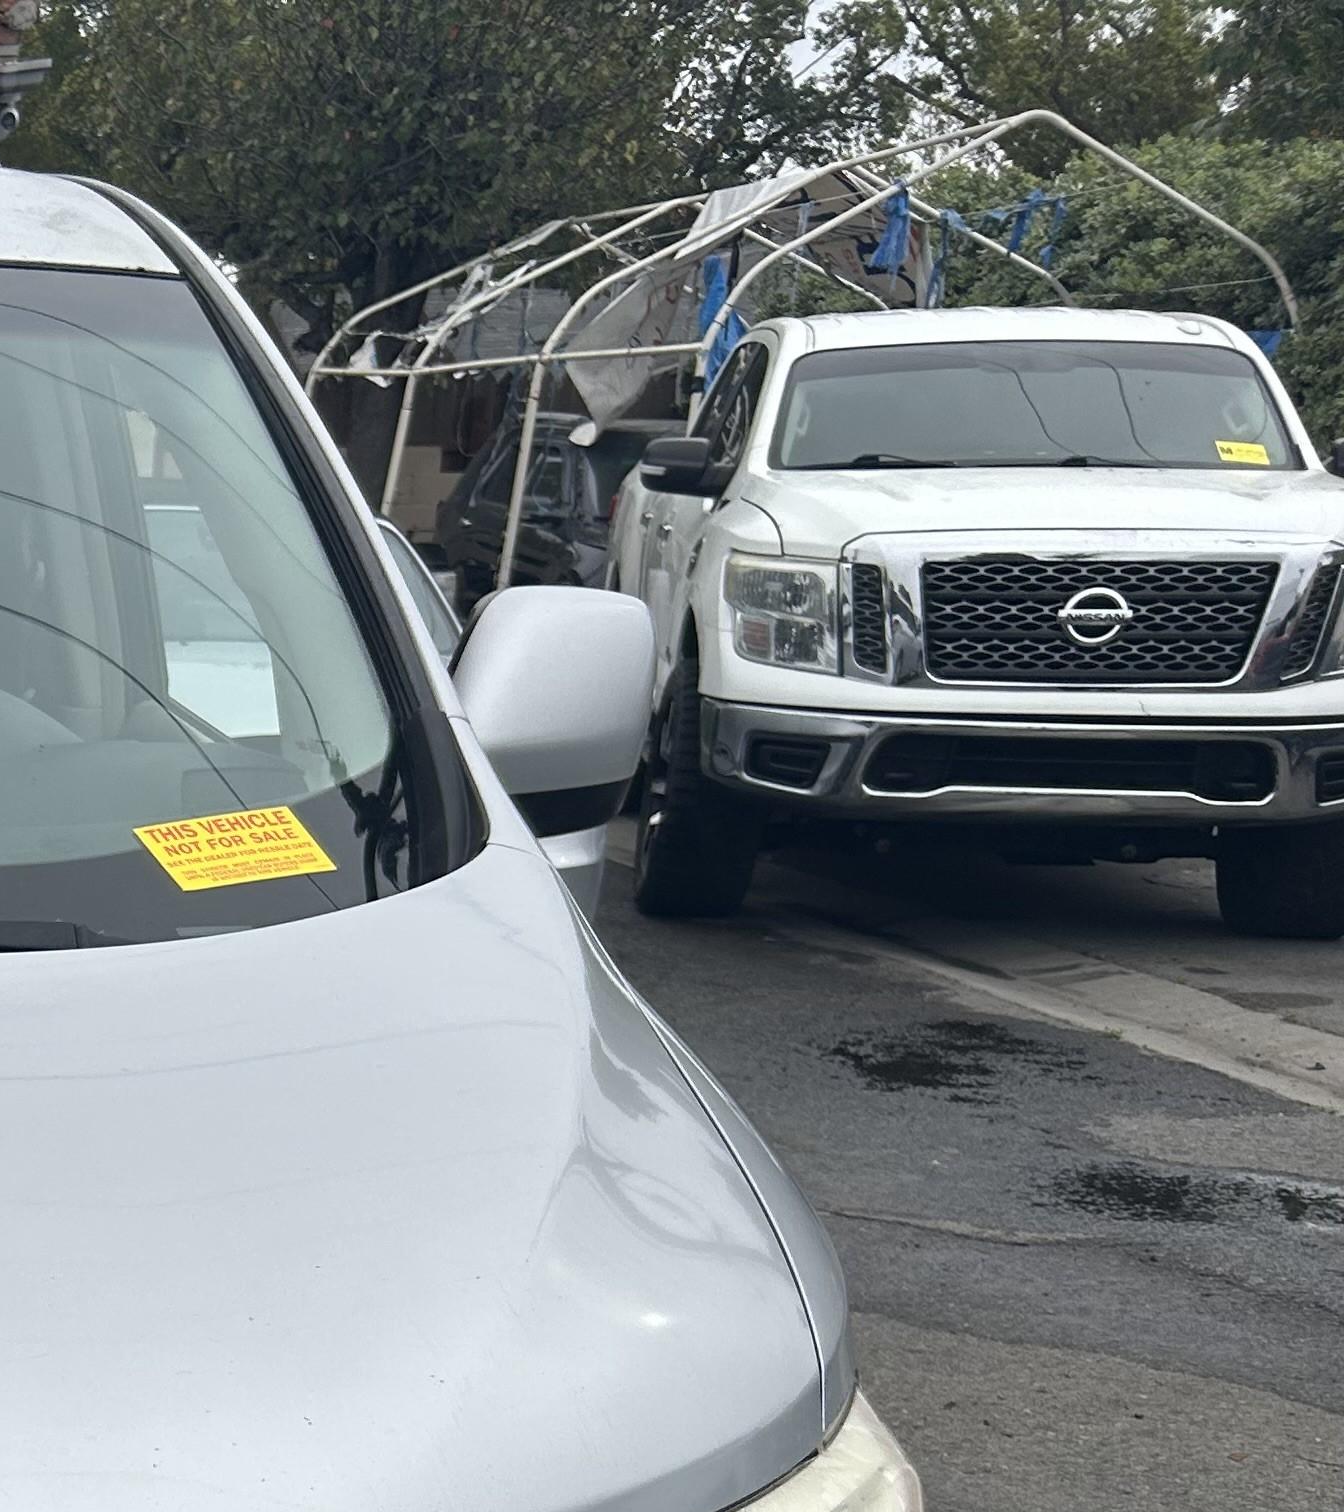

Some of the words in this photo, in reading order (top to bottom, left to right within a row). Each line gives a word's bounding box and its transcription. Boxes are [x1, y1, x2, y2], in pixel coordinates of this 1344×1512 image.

[143, 826, 197, 844] THIS
[197, 810, 292, 835] VEHICLE
[162, 841, 202, 858] NOT
[206, 835, 247, 850] FOR
[249, 828, 300, 844] SALE
[167, 860, 184, 868] SEE
[186, 857, 202, 866] THE
[204, 851, 238, 862] DEALER
